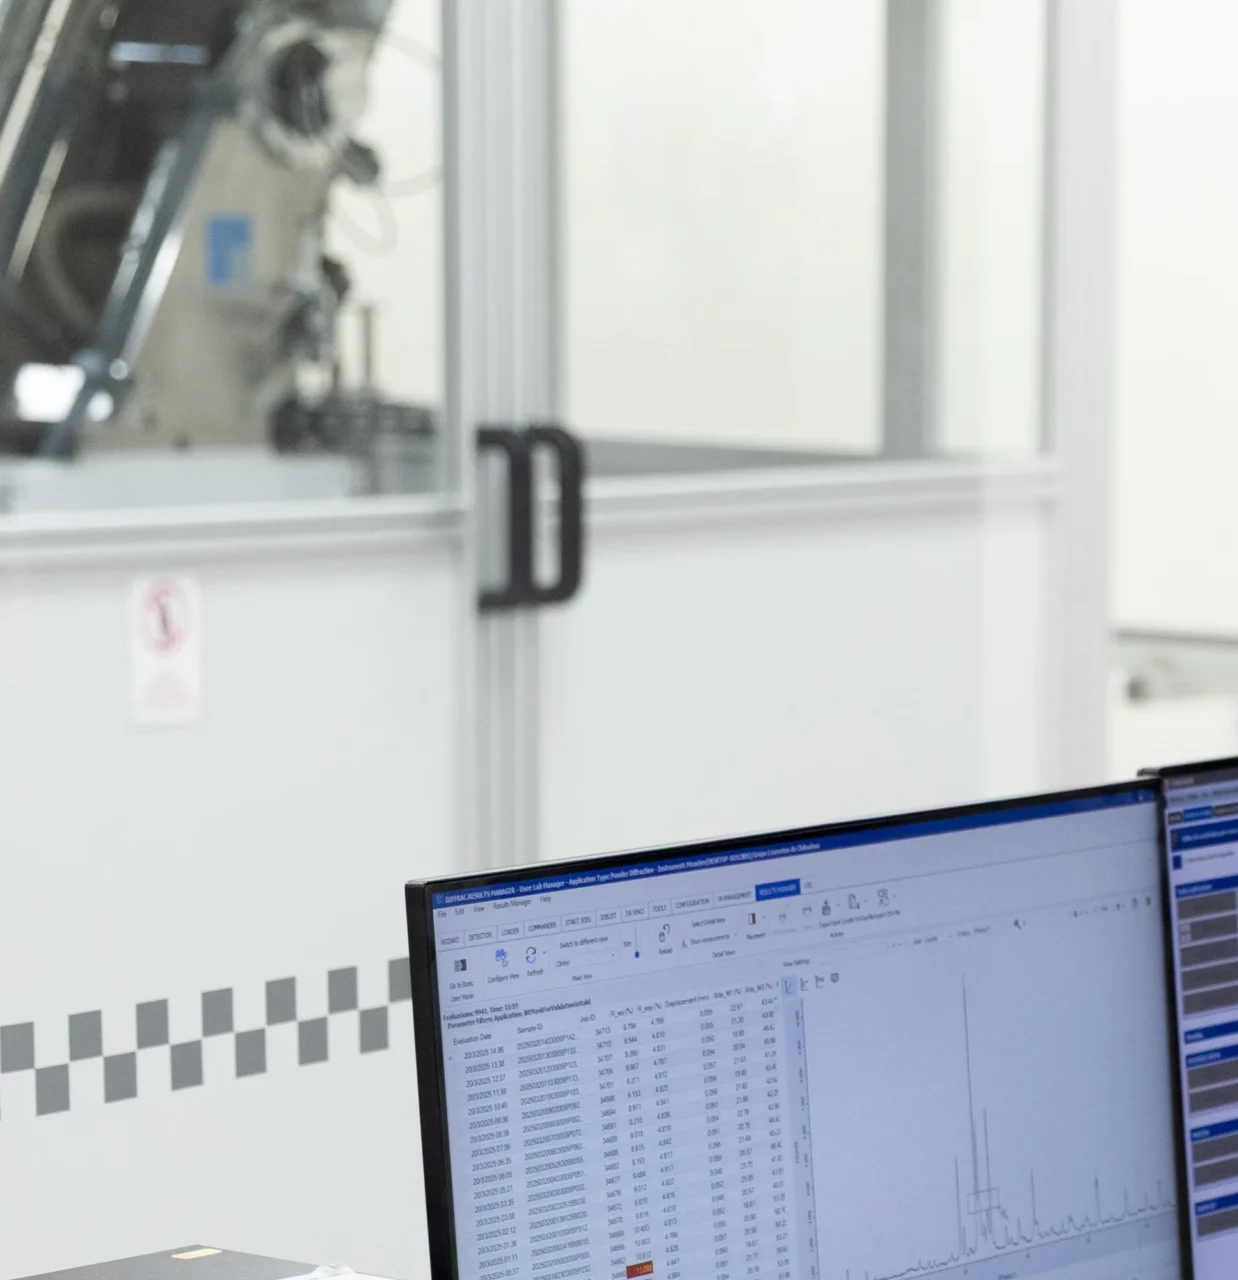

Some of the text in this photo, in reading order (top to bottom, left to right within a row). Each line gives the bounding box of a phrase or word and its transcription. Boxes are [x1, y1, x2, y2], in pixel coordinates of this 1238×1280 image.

[490, 886, 515, 896] MANAGER
[543, 879, 565, 890] Manager
[569, 875, 596, 886] Application
[437, 910, 446, 918] File
[473, 905, 484, 913] View
[493, 901, 510, 910] Results
[511, 898, 531, 908] Manager
[540, 895, 551, 904] Help
[440, 936, 460, 946] WIZARD
[468, 931, 492, 941] DETECTOR
[501, 927, 519, 936] LOADER
[528, 921, 556, 932] COMMANDER
[565, 918, 579, 926] START
[674, 898, 710, 909] CONFIGURATION
[559, 941, 573, 949] Switch
[579, 937, 597, 946] different
[487, 972, 519, 984] Configure View
[526, 968, 544, 977] Refresh
[461, 992, 474, 1000] Mode
[489, 1005, 503, 1013] Time:
[504, 1003, 518, 1011] 15:19
[447, 1019, 475, 1030] Parameter
[453, 1034, 479, 1046] Evaluation
[480, 1032, 492, 1041] Date
[517, 1024, 536, 1035] Sample
[536, 1023, 543, 1031] ID
[579, 1015, 589, 1023] Job
[665, 996, 697, 1009] Displacement
